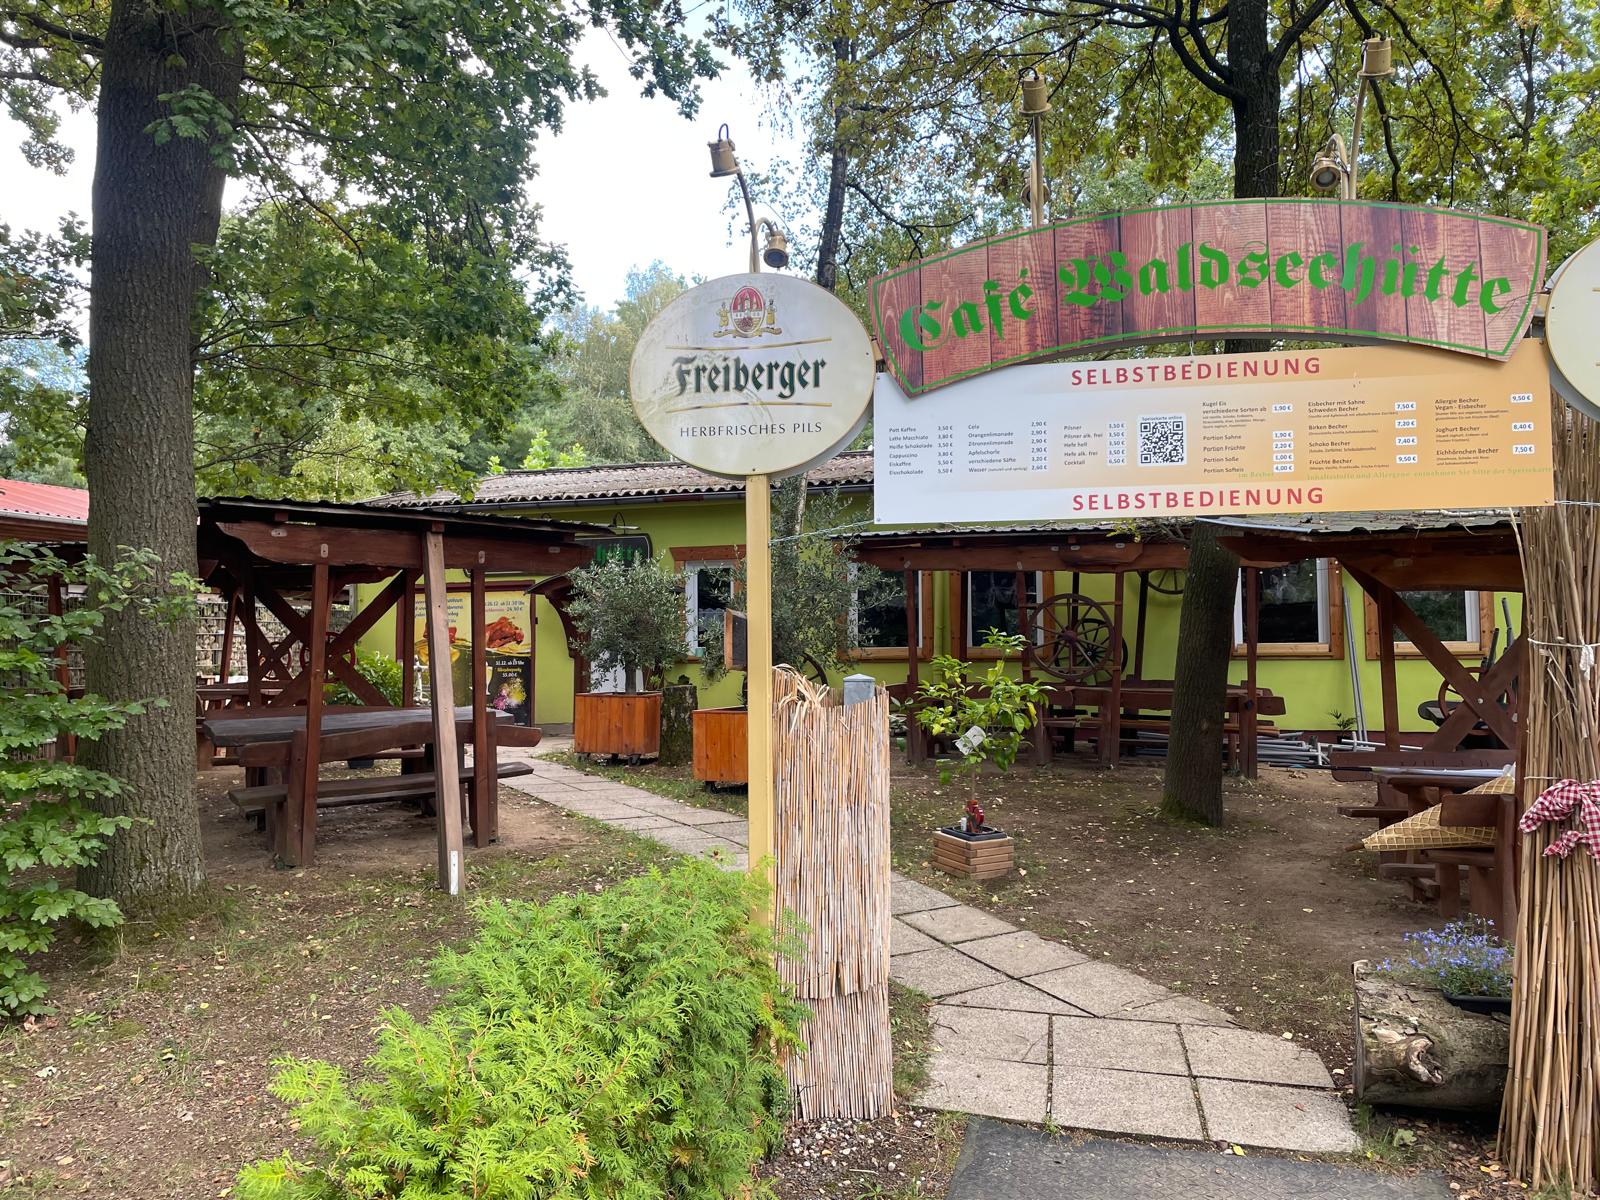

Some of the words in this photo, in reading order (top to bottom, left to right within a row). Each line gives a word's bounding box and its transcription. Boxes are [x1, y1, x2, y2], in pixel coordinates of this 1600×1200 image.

[904, 270, 1037, 352] Café
[1058, 241, 1511, 315] Waldseehütte
[672, 355, 826, 399] Freiberger
[1071, 357, 1320, 385] SELBSTBEDIENUNG
[680, 424, 785, 437] HERBFRISCHES
[793, 422, 822, 433] PILS
[1073, 487, 1323, 511] SELBSTBEDIENUNG
